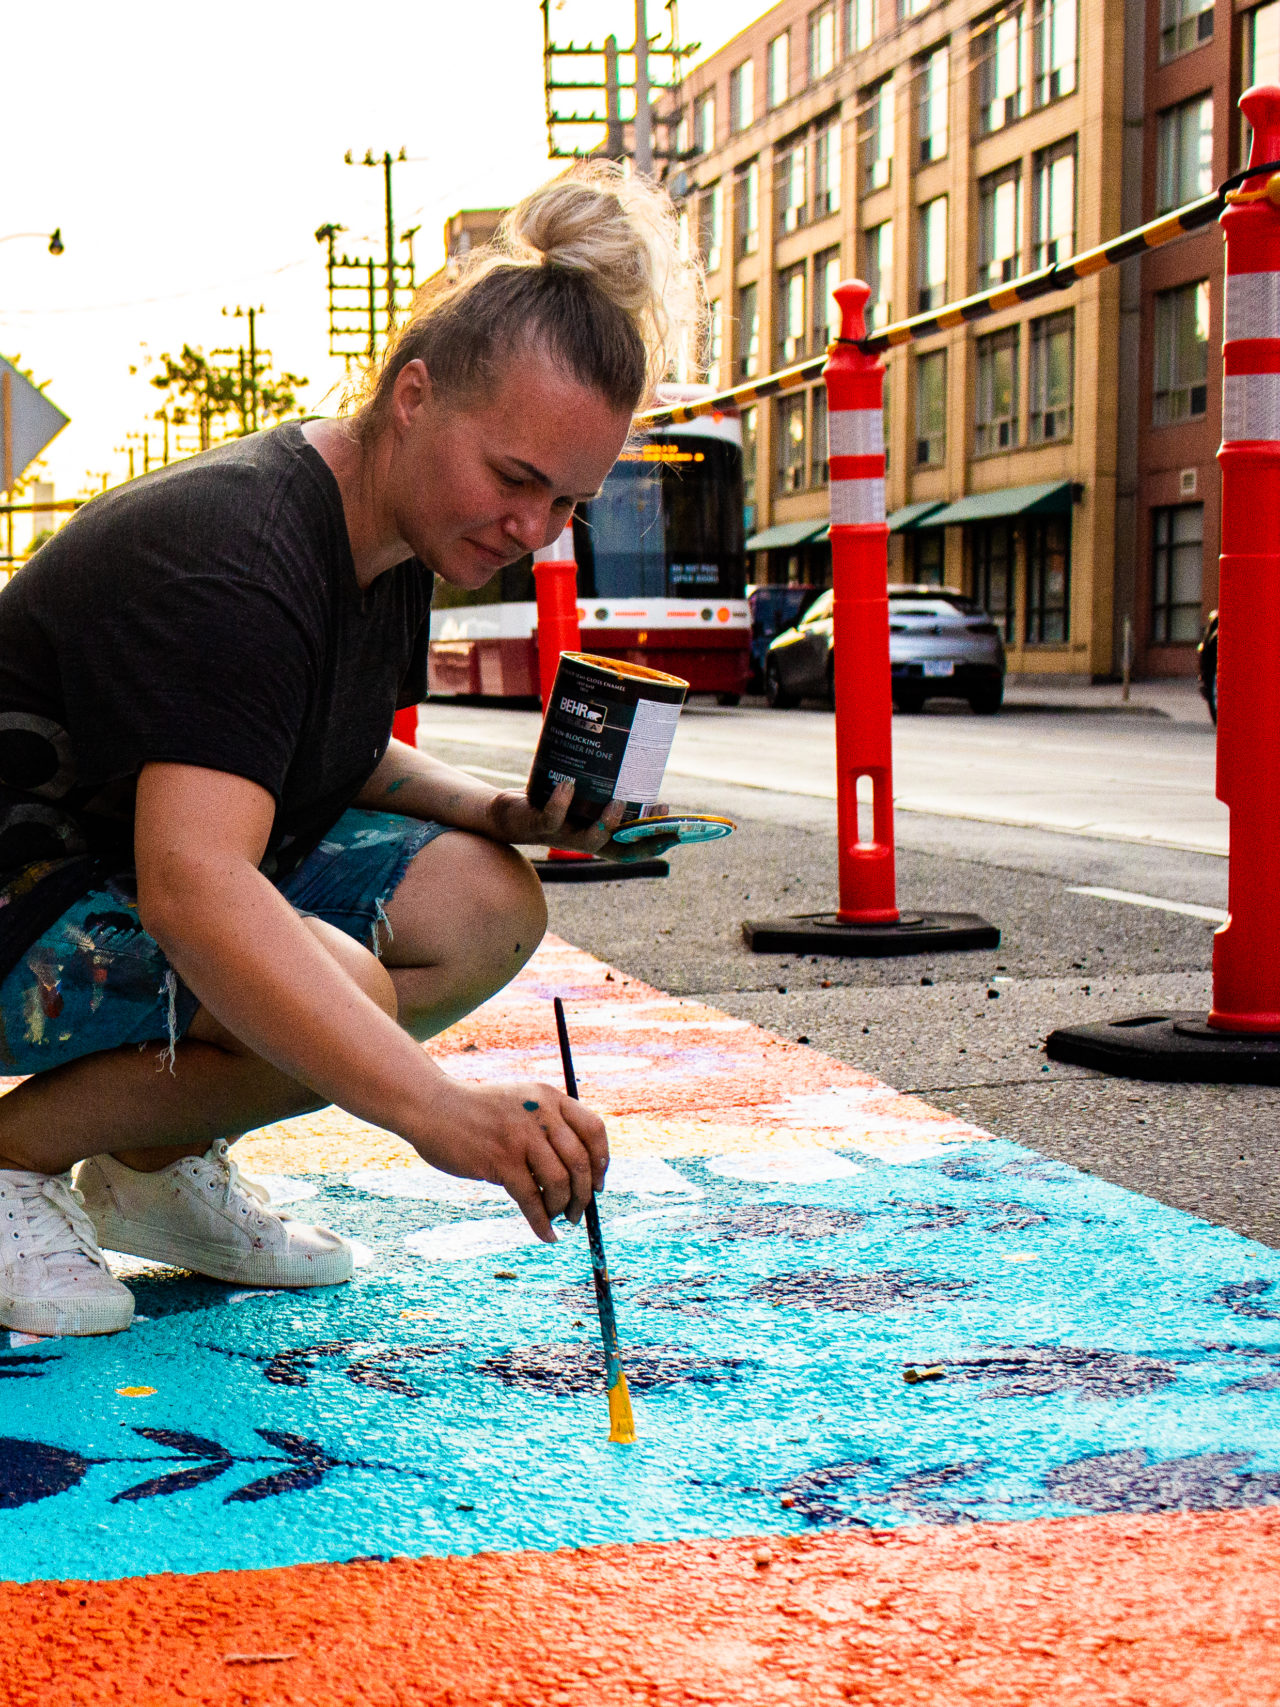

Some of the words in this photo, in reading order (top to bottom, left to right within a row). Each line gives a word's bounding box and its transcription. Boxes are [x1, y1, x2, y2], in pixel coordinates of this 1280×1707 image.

[560, 696, 588, 718] BEHR
[595, 750, 613, 760] ONE
[548, 769, 576, 785] CAUTION
